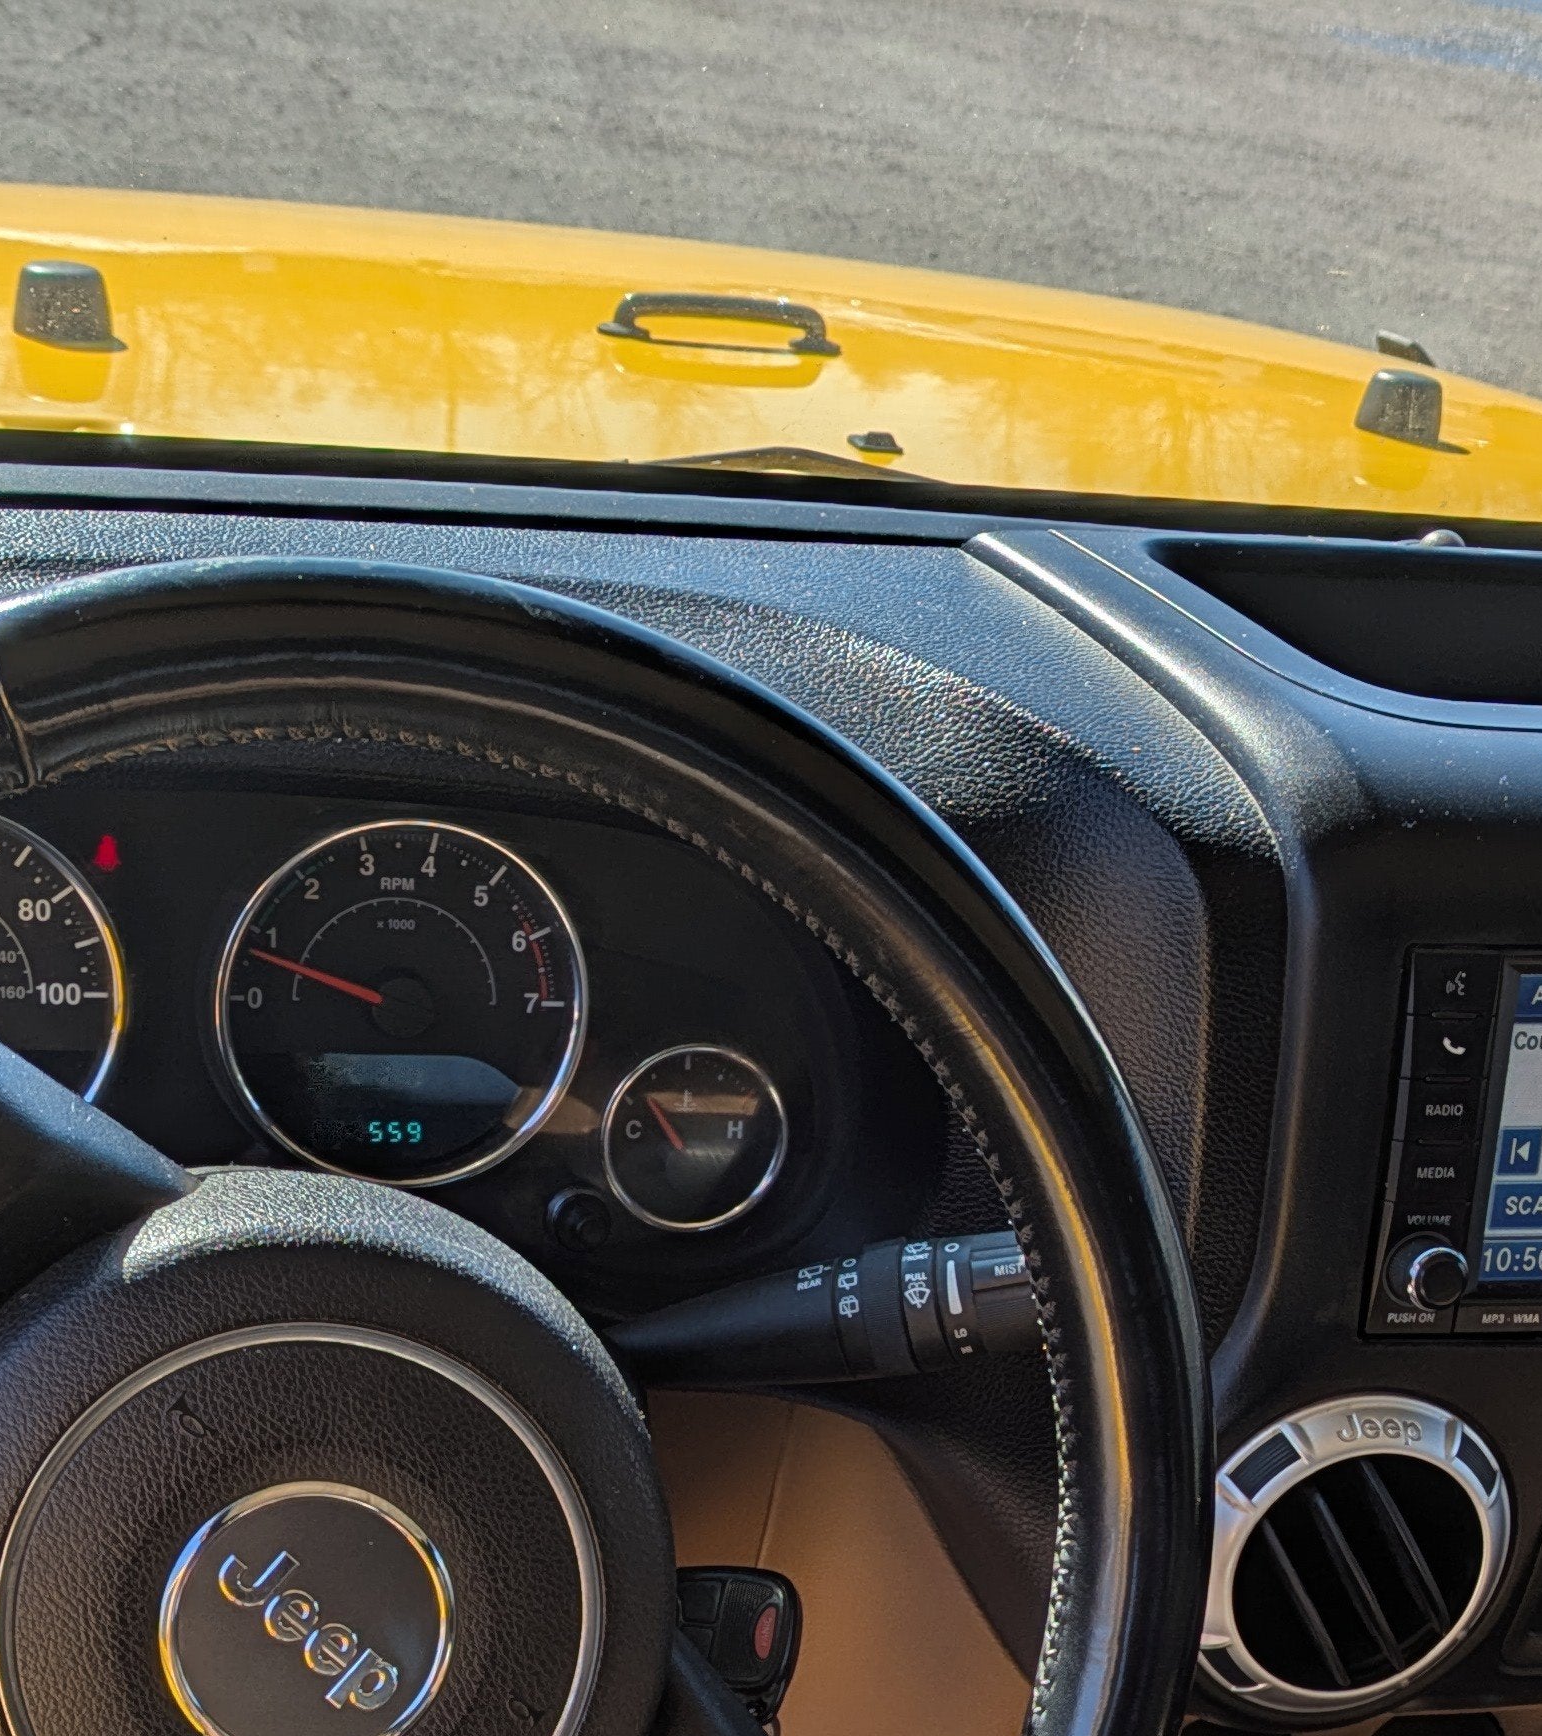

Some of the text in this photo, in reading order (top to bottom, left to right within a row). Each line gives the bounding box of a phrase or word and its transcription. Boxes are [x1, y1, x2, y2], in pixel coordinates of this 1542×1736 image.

[360, 853, 376, 876] 3
[420, 856, 437, 878] 4
[304, 878, 320, 900] 2
[380, 877, 416, 891] RPM
[474, 885, 489, 907] 5
[18, 898, 51, 922] 80
[387, 918, 416, 931] 1000
[266, 927, 277, 948] 1
[511, 929, 527, 952] 6
[0, 986, 26, 1000] 160
[36, 982, 81, 1006] 100
[247, 987, 262, 1009] 0
[524, 992, 540, 1013] 7
[1425, 1104, 1464, 1118] RADIO
[367, 1119, 423, 1144] 559
[625, 1120, 642, 1140] C
[726, 1119, 744, 1140] H
[1416, 1166, 1455, 1180] MEDIA
[1407, 1214, 1452, 1227] VOLUME
[903, 1271, 929, 1282] PULL
[993, 1261, 1024, 1278] MIST
[796, 1276, 823, 1292] REAR
[1386, 1312, 1435, 1324] PUSH ON
[1481, 1313, 1505, 1325] MP3
[1512, 1313, 1541, 1325] WMA
[1335, 1411, 1424, 1446] Jeep
[218, 1549, 401, 1712] Jeep
